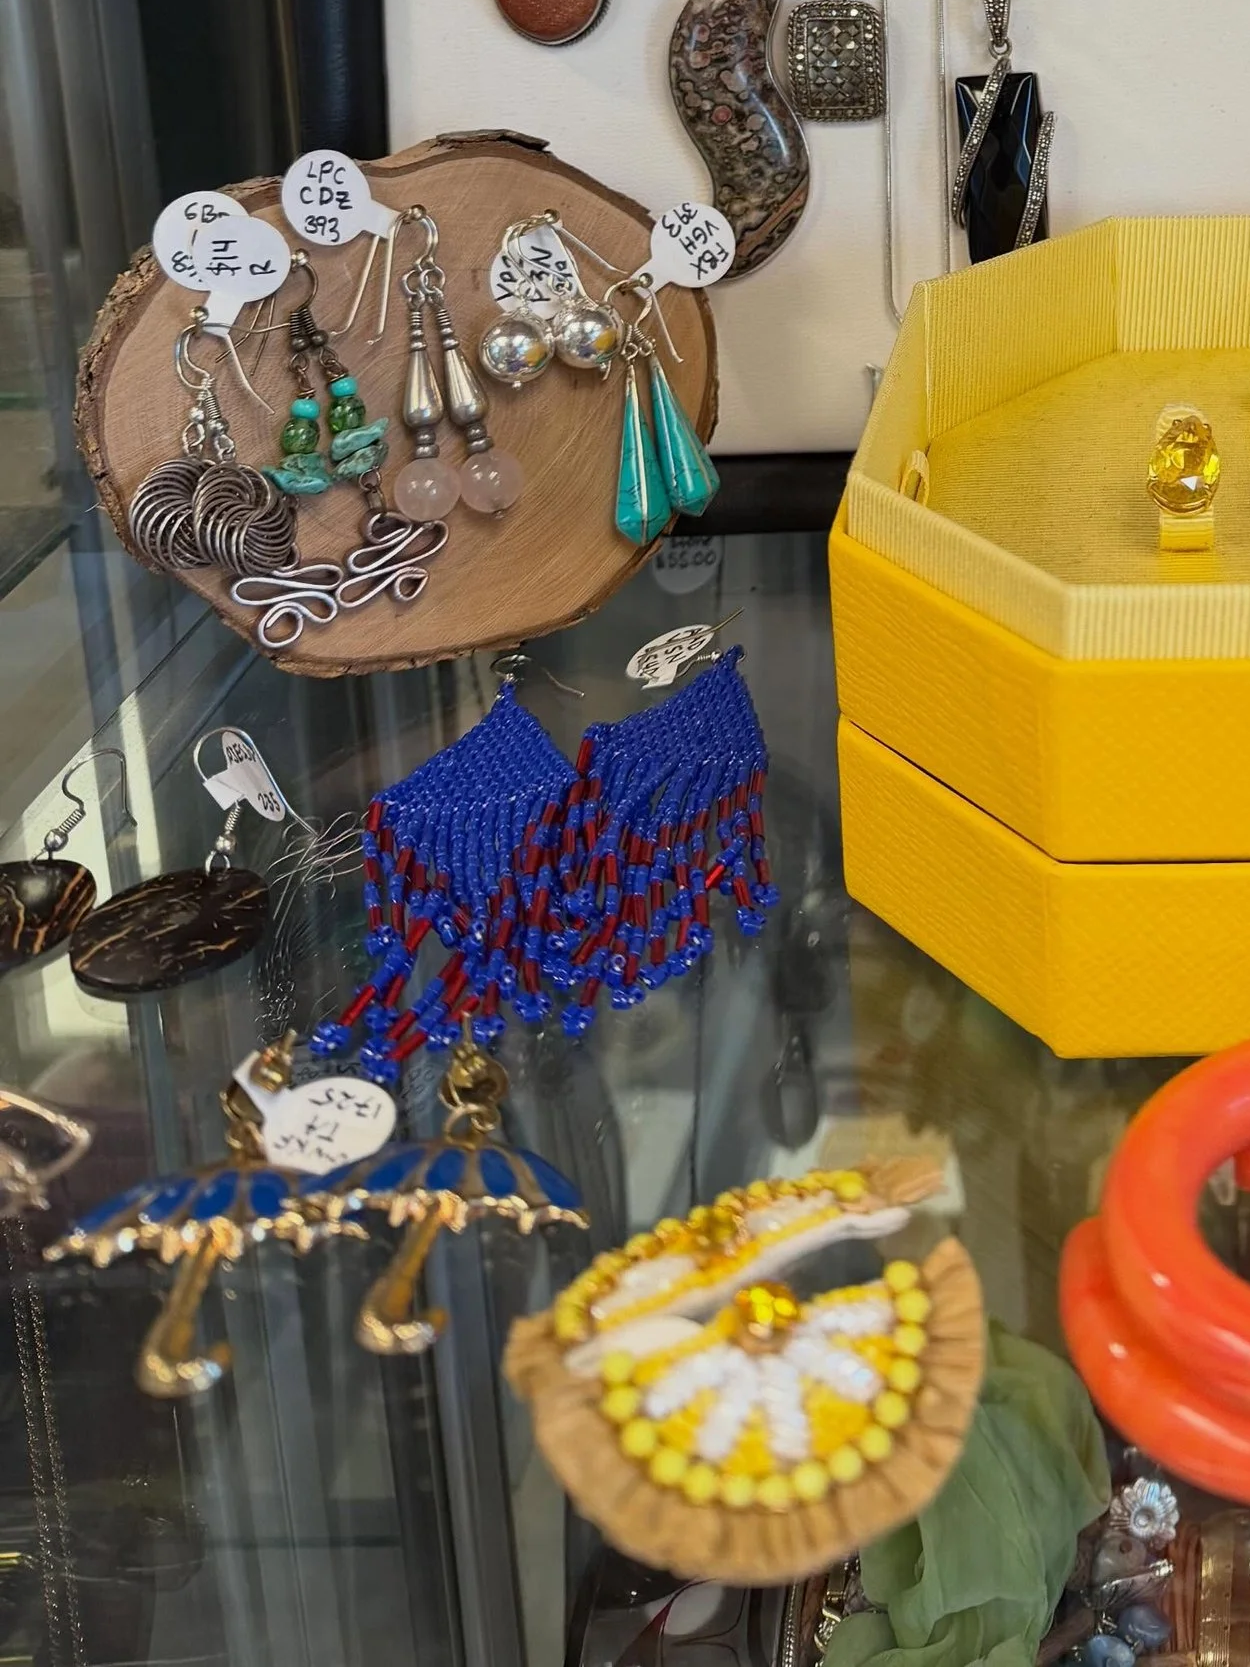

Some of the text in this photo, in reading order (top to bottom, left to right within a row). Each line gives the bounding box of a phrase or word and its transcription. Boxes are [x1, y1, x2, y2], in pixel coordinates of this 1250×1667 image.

[306, 160, 347, 184] LPC
[299, 185, 354, 210] CDZ
[303, 215, 341, 242] 393
[660, 201, 698, 238] 393
[679, 220, 720, 255] VGH
[205, 238, 242, 276] $14
[249, 258, 277, 276] R
[690, 242, 729, 280] FBX
